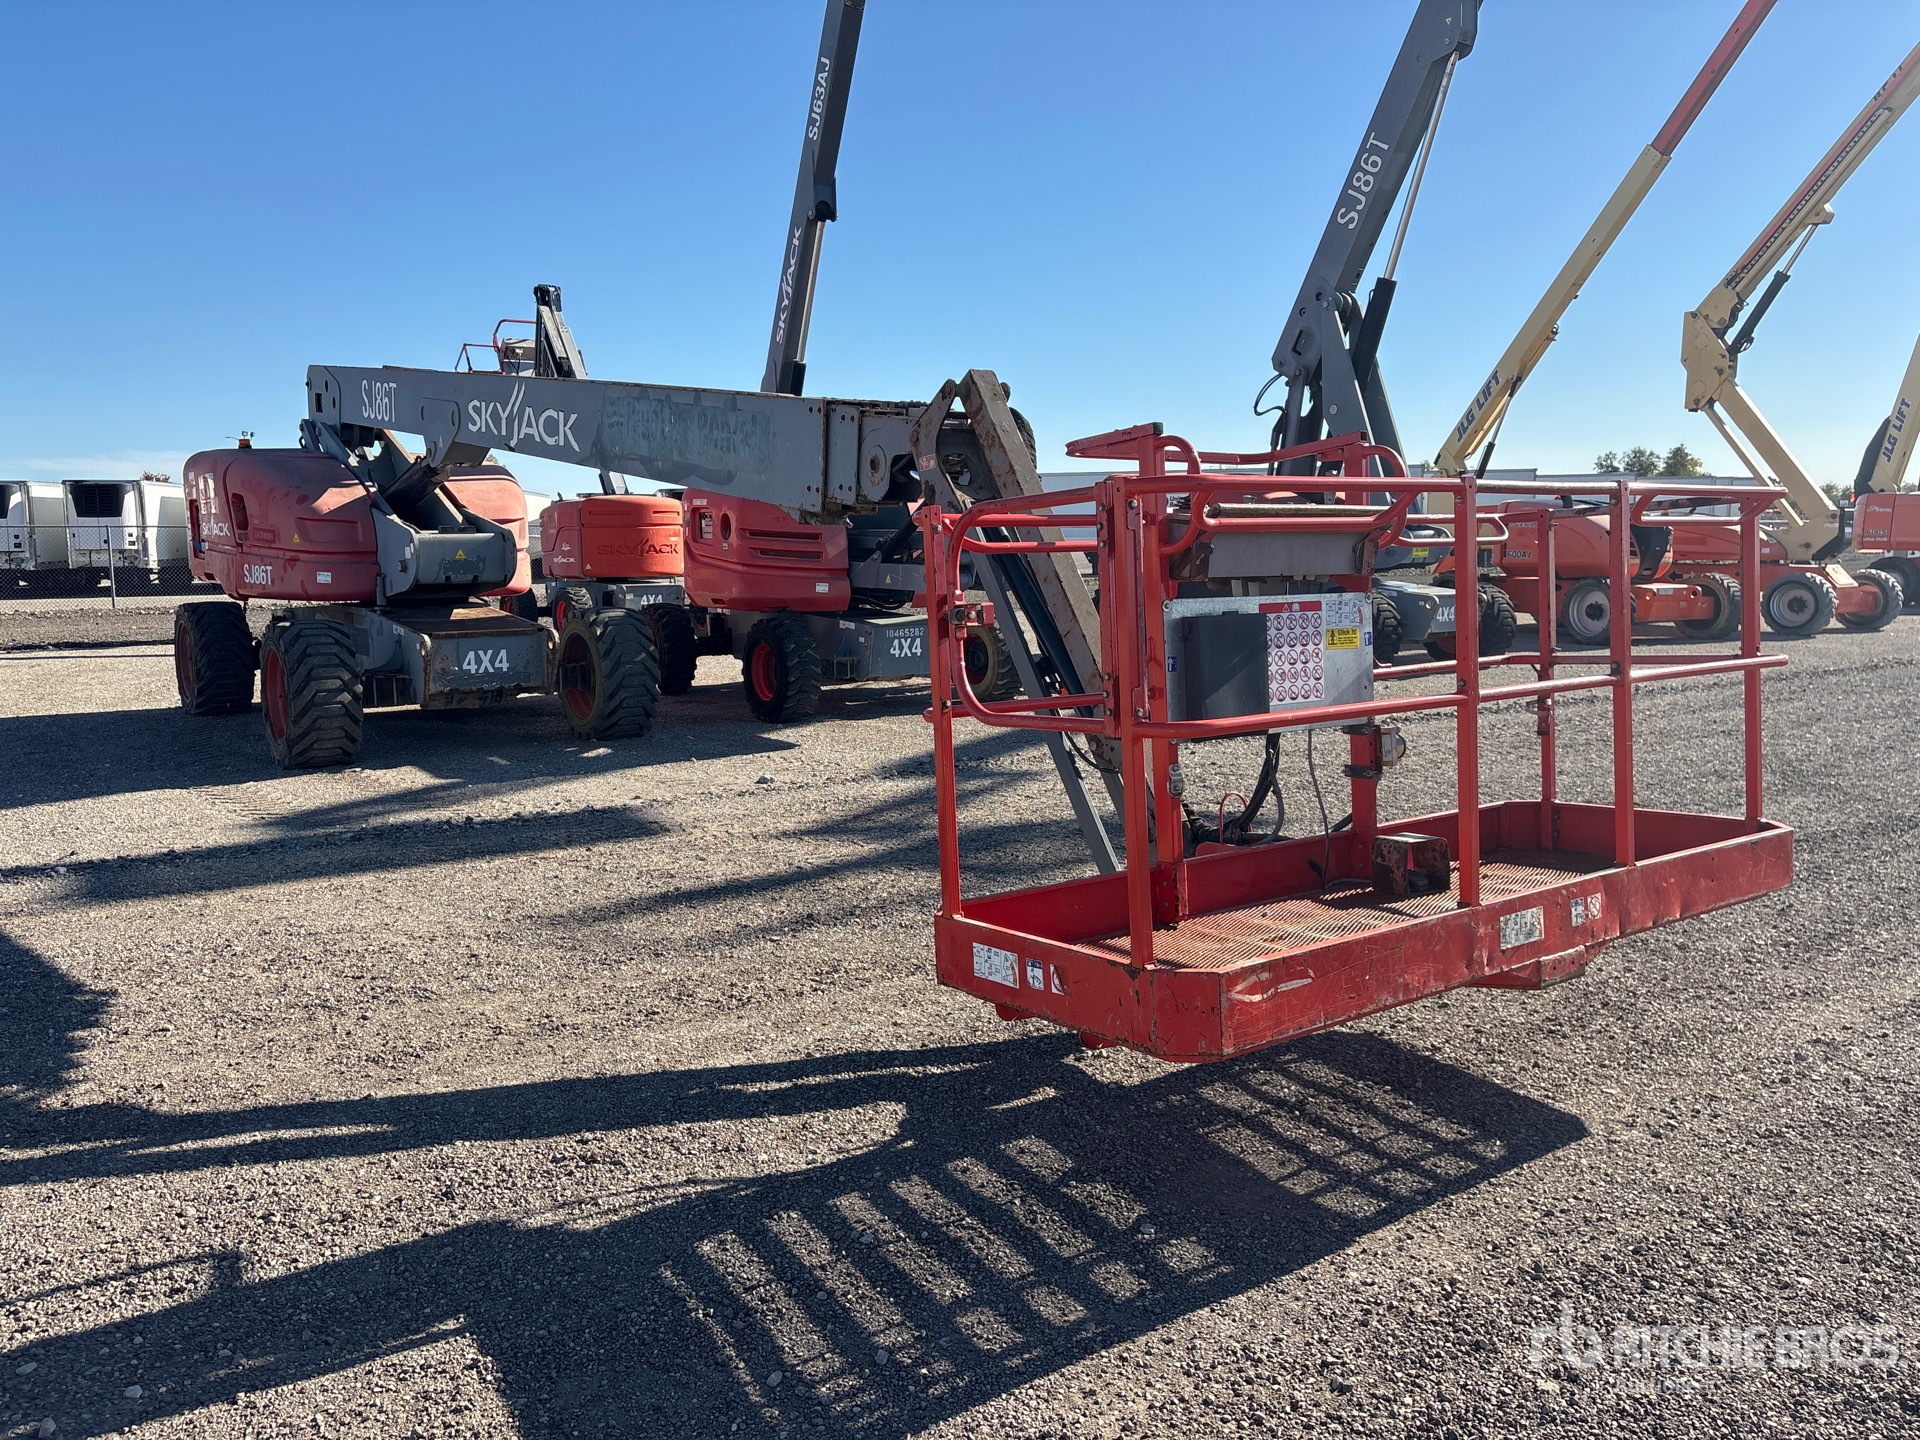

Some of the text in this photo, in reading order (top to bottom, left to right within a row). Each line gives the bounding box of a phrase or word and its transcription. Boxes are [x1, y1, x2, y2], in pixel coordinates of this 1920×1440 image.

[808, 56, 830, 141] SJ63AJ
[1336, 131, 1390, 230] SJ86T
[776, 225, 802, 345] SKYJACK
[361, 379, 397, 423] SJ86T
[1456, 369, 1500, 443] JLG LIFT
[467, 380, 581, 453] SKYJACK
[1882, 397, 1911, 463] JLG LIFT
[202, 514, 231, 538] SKYJACK
[597, 537, 679, 559] SKYJACK
[1507, 550, 1532, 559] 600AJ
[243, 563, 273, 586] SJ86T
[640, 594, 663, 605] 4X4
[1436, 604, 1456, 622] 4X4
[886, 627, 925, 638] 10465282
[890, 638, 922, 658] 4X4
[462, 649, 510, 674] 4X4
